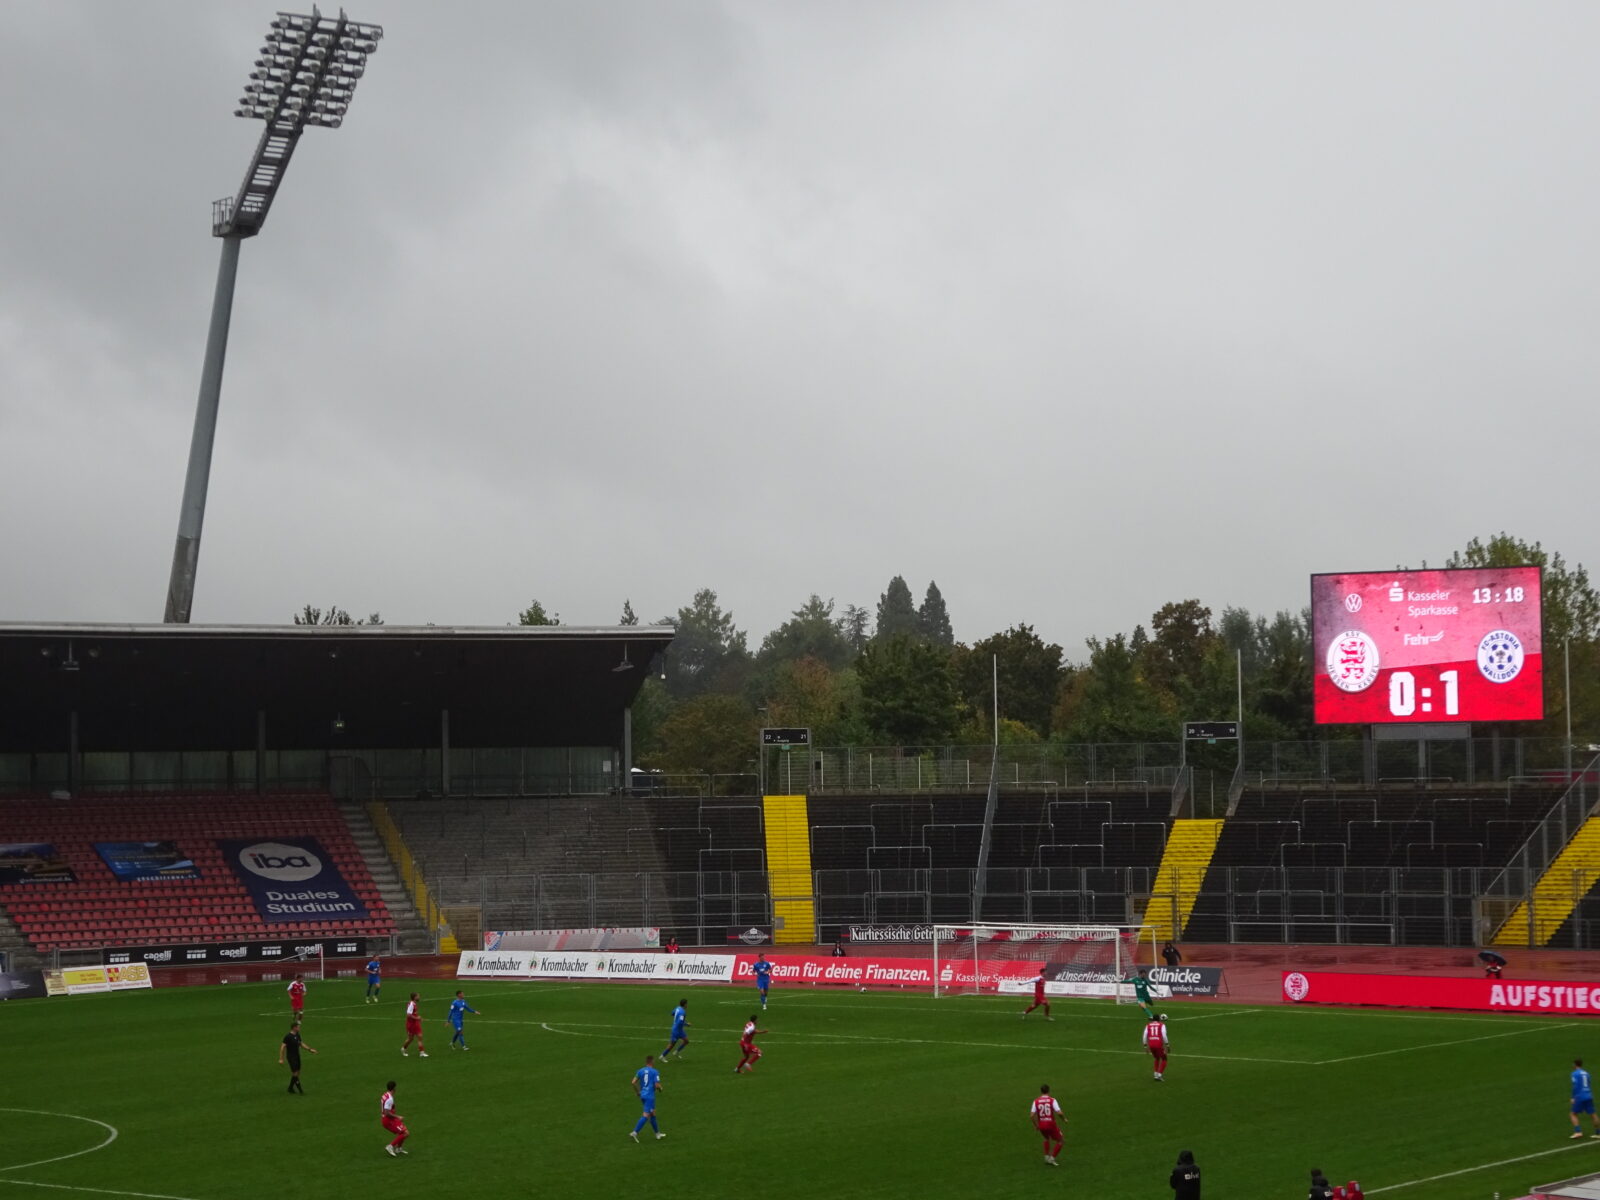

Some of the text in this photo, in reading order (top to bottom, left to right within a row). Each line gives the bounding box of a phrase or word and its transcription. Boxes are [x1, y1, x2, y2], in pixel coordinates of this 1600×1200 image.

[1407, 590, 1450, 602] Kasseler
[1407, 605, 1459, 618] Sparkasse
[1404, 633, 1430, 646] Fehr
[248, 853, 312, 869] iba
[266, 890, 340, 901] Duales
[266, 902, 355, 914] Studium
[850, 926, 955, 941] Kurhessische Getrnke
[143, 950, 172, 961] capelli
[219, 947, 248, 957] capelli
[477, 957, 521, 970] Krombacher
[540, 957, 588, 971] Krombacher
[607, 959, 657, 973] Krombacher
[677, 960, 727, 975] Krombacher
[738, 961, 757, 976] Da
[802, 961, 823, 978] für
[825, 963, 862, 979] deine
[865, 964, 930, 981] Finanzen.
[1148, 968, 1201, 983] Glinicke
[1172, 985, 1211, 993] einfach mobil
[1151, 1026, 1158, 1036] 11
[1038, 1103, 1051, 1117] 26
